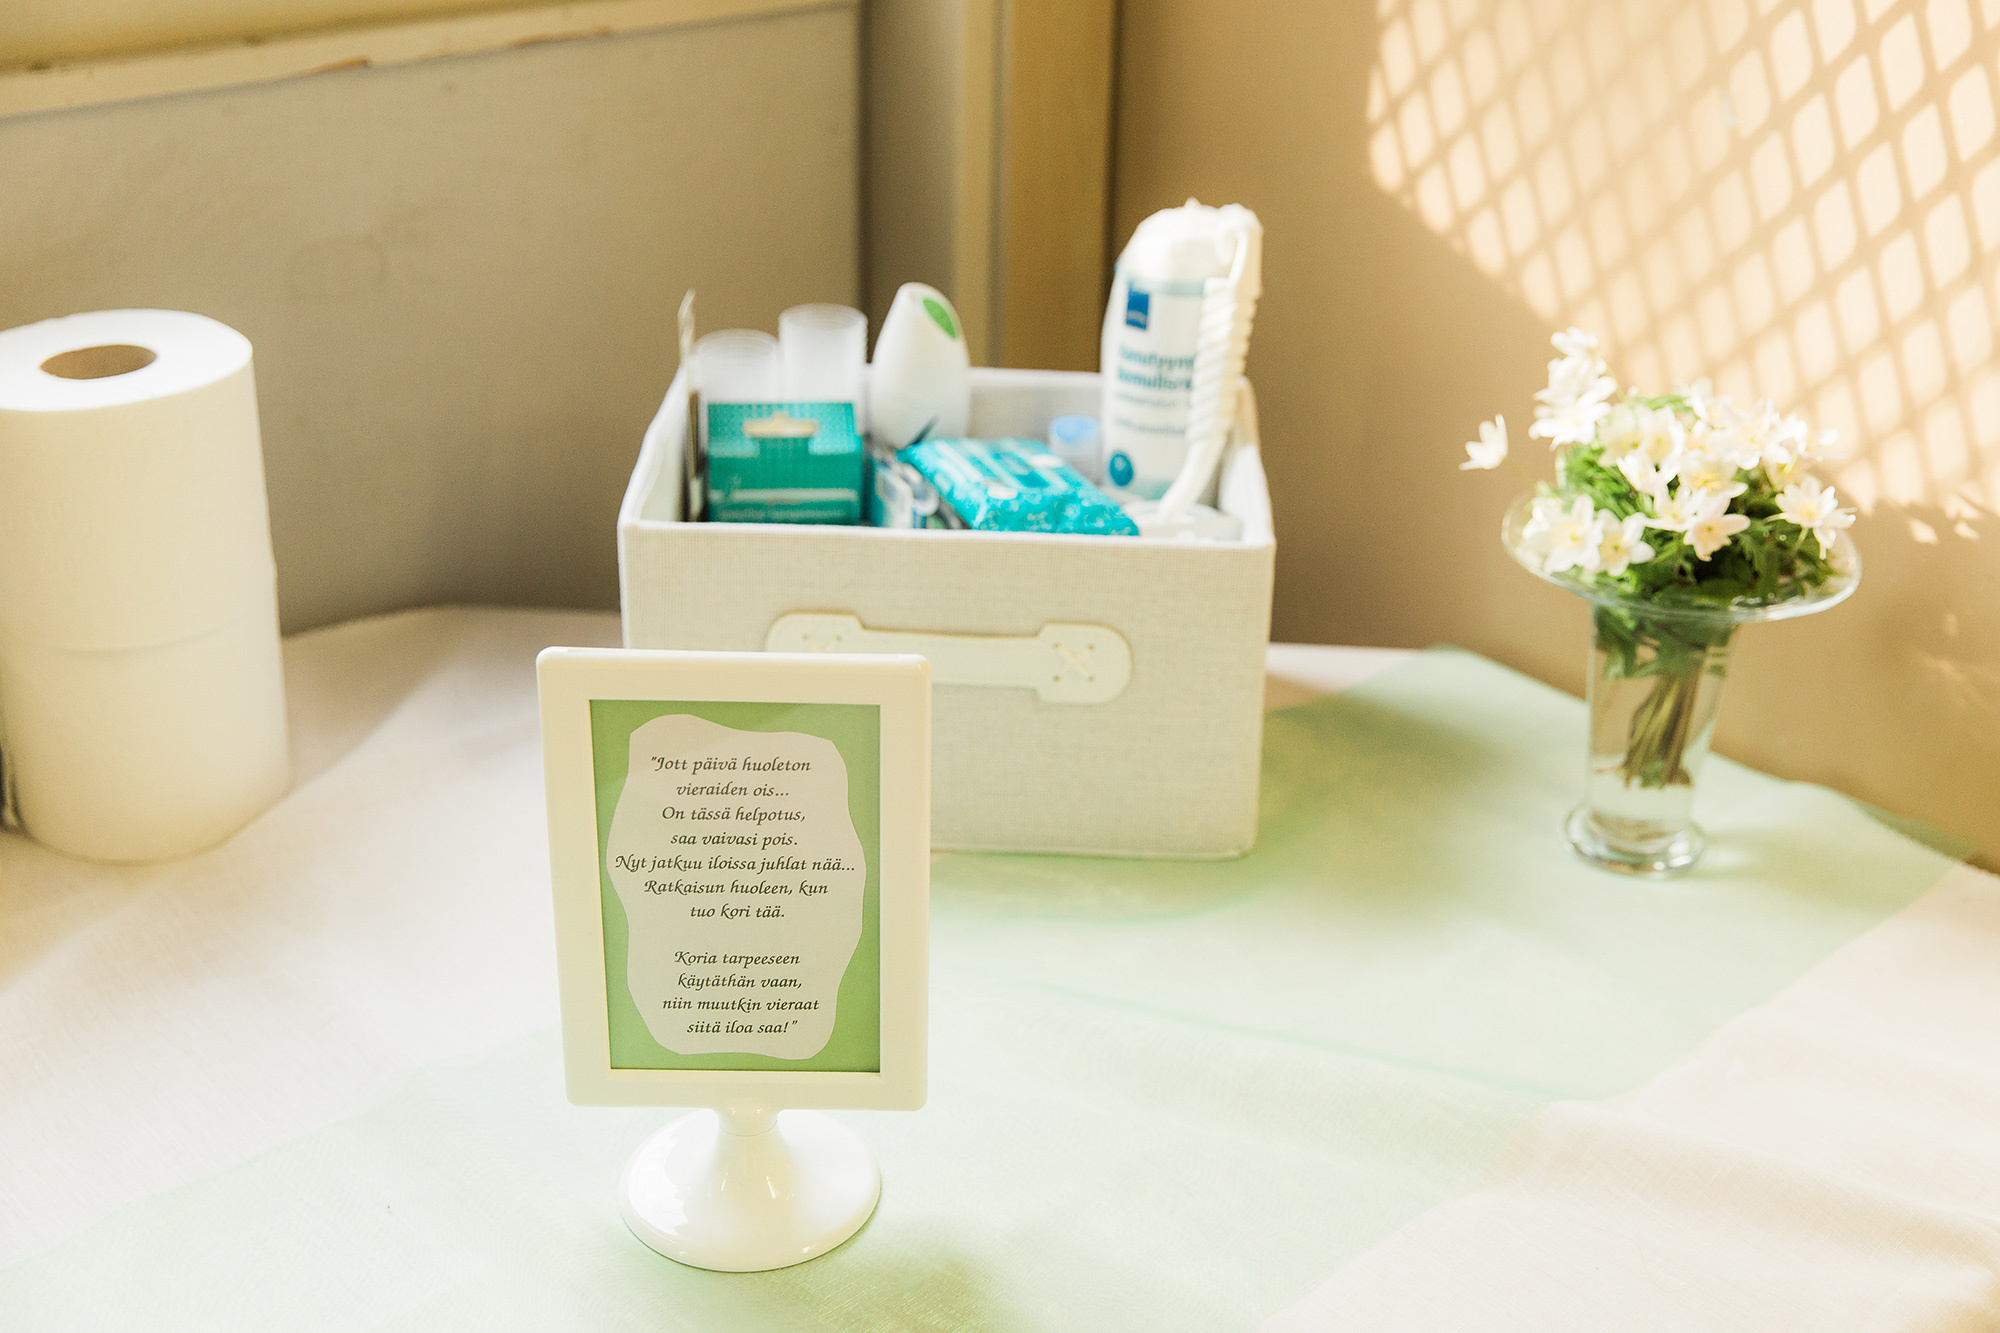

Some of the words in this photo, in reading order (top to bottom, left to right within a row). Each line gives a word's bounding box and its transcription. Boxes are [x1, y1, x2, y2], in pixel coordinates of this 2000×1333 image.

[691, 757, 738, 776] päivä
[741, 756, 812, 772] huoleton
[675, 780, 749, 796] vieraiden
[661, 806, 686, 820] On
[690, 806, 732, 821] tässä
[735, 805, 806, 827] helpotus,
[670, 834, 698, 846] saa
[701, 831, 759, 846] vaivasi
[760, 832, 798, 851] pois.
[615, 853, 648, 873] Nyt
[647, 854, 704, 874] jatkuu
[707, 854, 757, 871] iloissa
[756, 855, 808, 876] juhlat
[643, 878, 726, 896] Ratkaisun
[729, 879, 793, 896] huoleen,
[798, 879, 829, 897] kun
[689, 906, 716, 918] tuo
[720, 902, 751, 920] kori
[755, 905, 785, 919] tää.
[674, 950, 718, 967] Koria
[722, 953, 801, 970] tarpeeseen
[677, 972, 757, 992] käytäthän
[760, 978, 802, 990] vaan,
[662, 996, 693, 1010] niin
[696, 996, 763, 1014] muutkin
[765, 998, 820, 1011] vieraat
[686, 1020, 722, 1034] siitä
[725, 1019, 754, 1034] iloa
